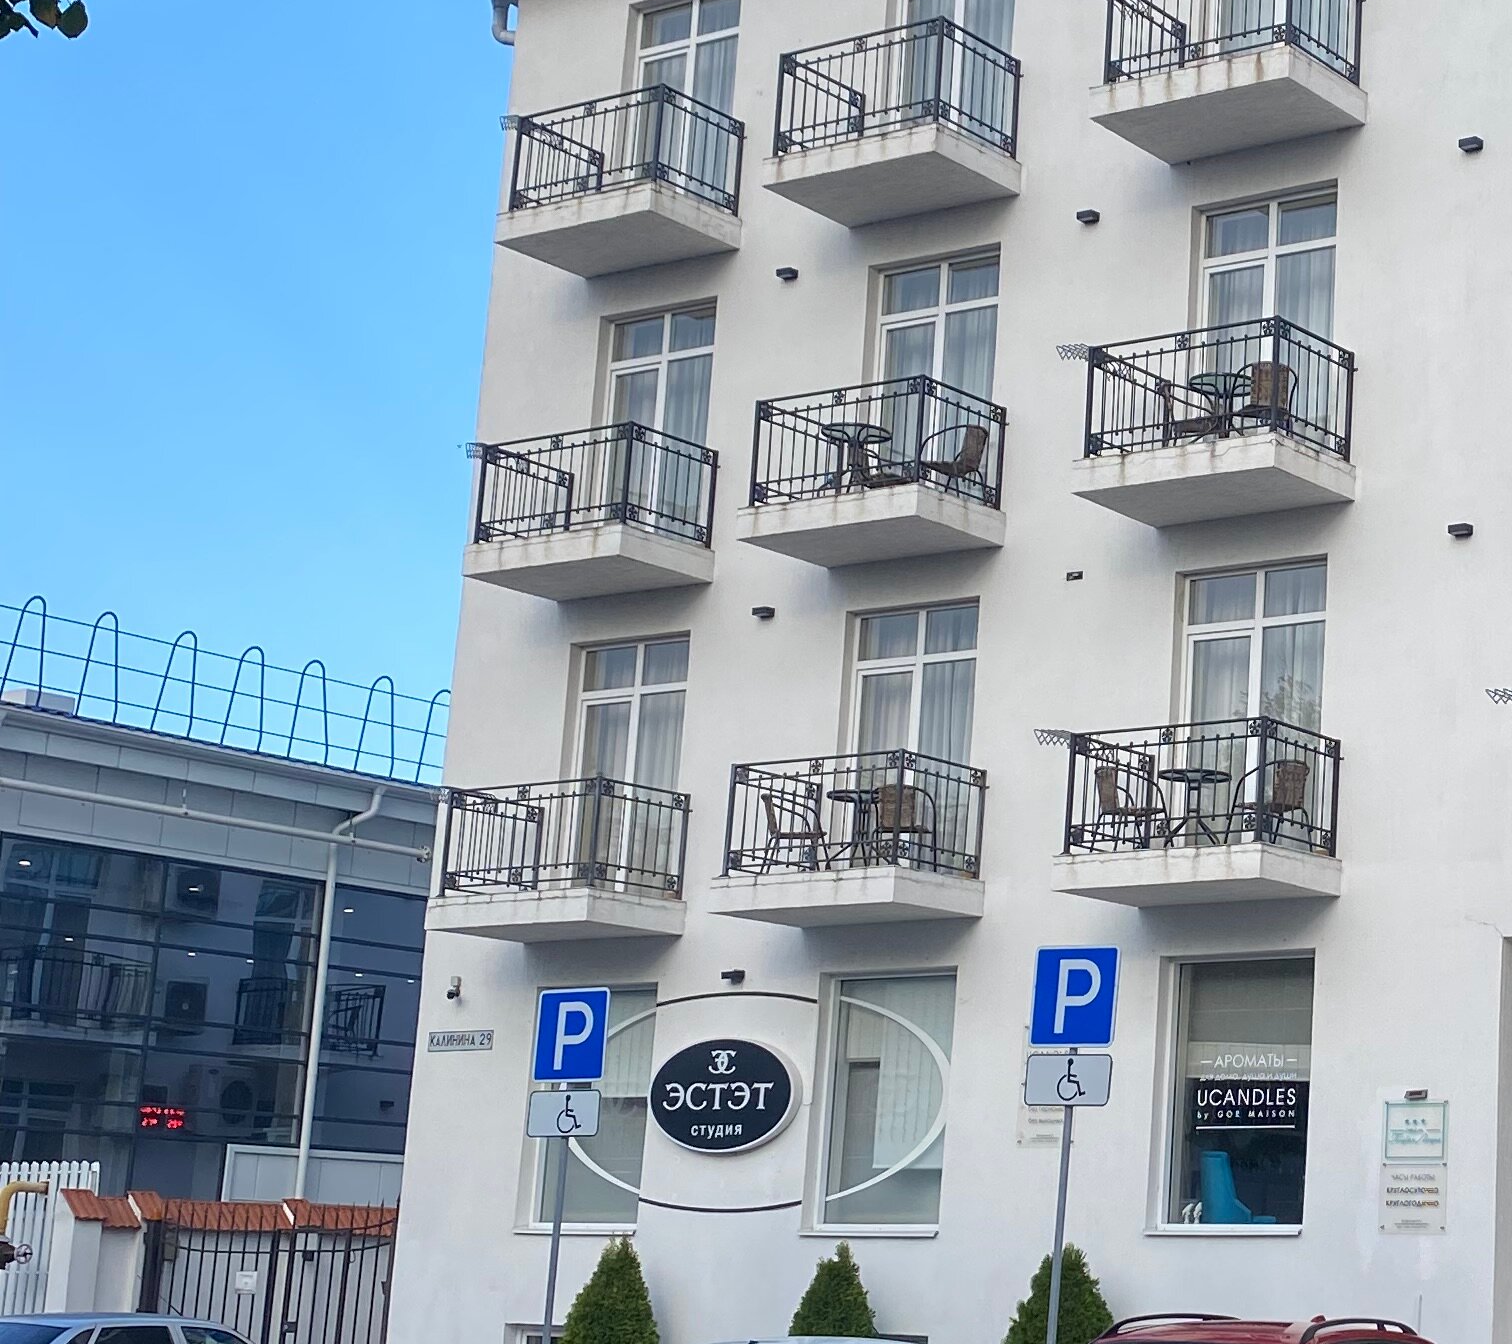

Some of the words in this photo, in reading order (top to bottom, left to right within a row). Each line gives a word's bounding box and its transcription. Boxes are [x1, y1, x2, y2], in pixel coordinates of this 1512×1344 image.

[1054, 959, 1101, 1034] P
[430, 1034, 476, 1047] КАЛИНИНА
[479, 1033, 492, 1046] 29
[553, 1001, 594, 1071] P
[1214, 1053, 1284, 1068] АРОМАТЫ
[662, 1081, 775, 1111] ЭСТЭТ
[1197, 1088, 1296, 1106] UCANDLES
[1197, 1111, 1209, 1120] by
[1248, 1110, 1295, 1118] MAISON
[691, 1124, 742, 1139] студия
